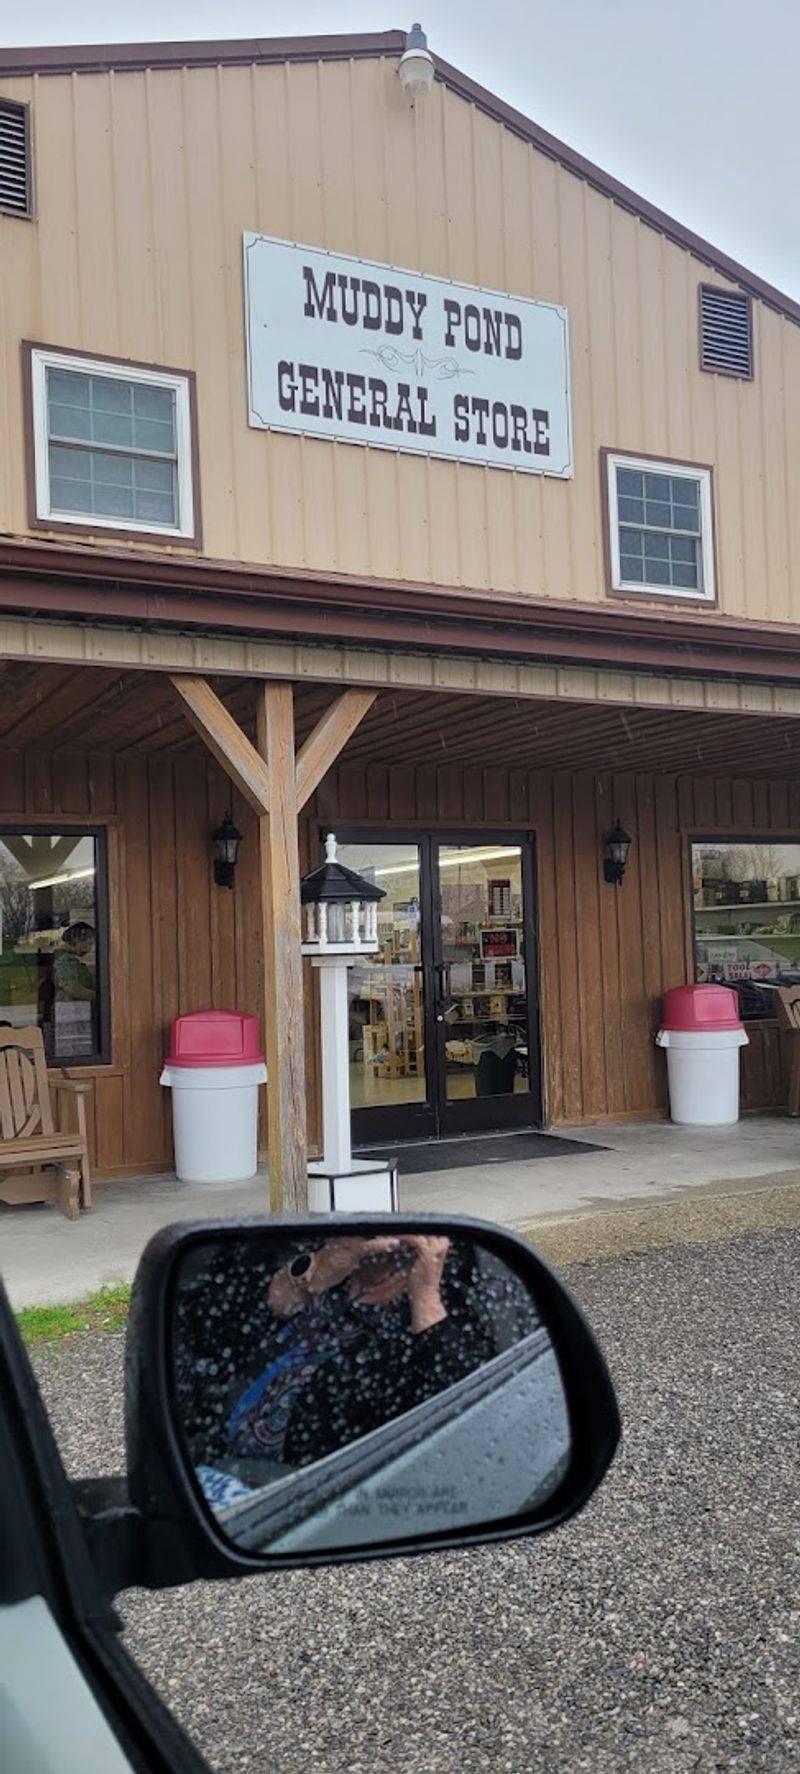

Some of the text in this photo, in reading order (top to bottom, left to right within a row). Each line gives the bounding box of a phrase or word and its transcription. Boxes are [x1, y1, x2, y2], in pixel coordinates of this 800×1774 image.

[302, 265, 523, 361] MUDDY POND
[277, 359, 550, 456] GENERAL STORE
[378, 1503, 410, 1515] THEY
[417, 1502, 468, 1514] APPEAR
[431, 1486, 457, 1498] ARE
